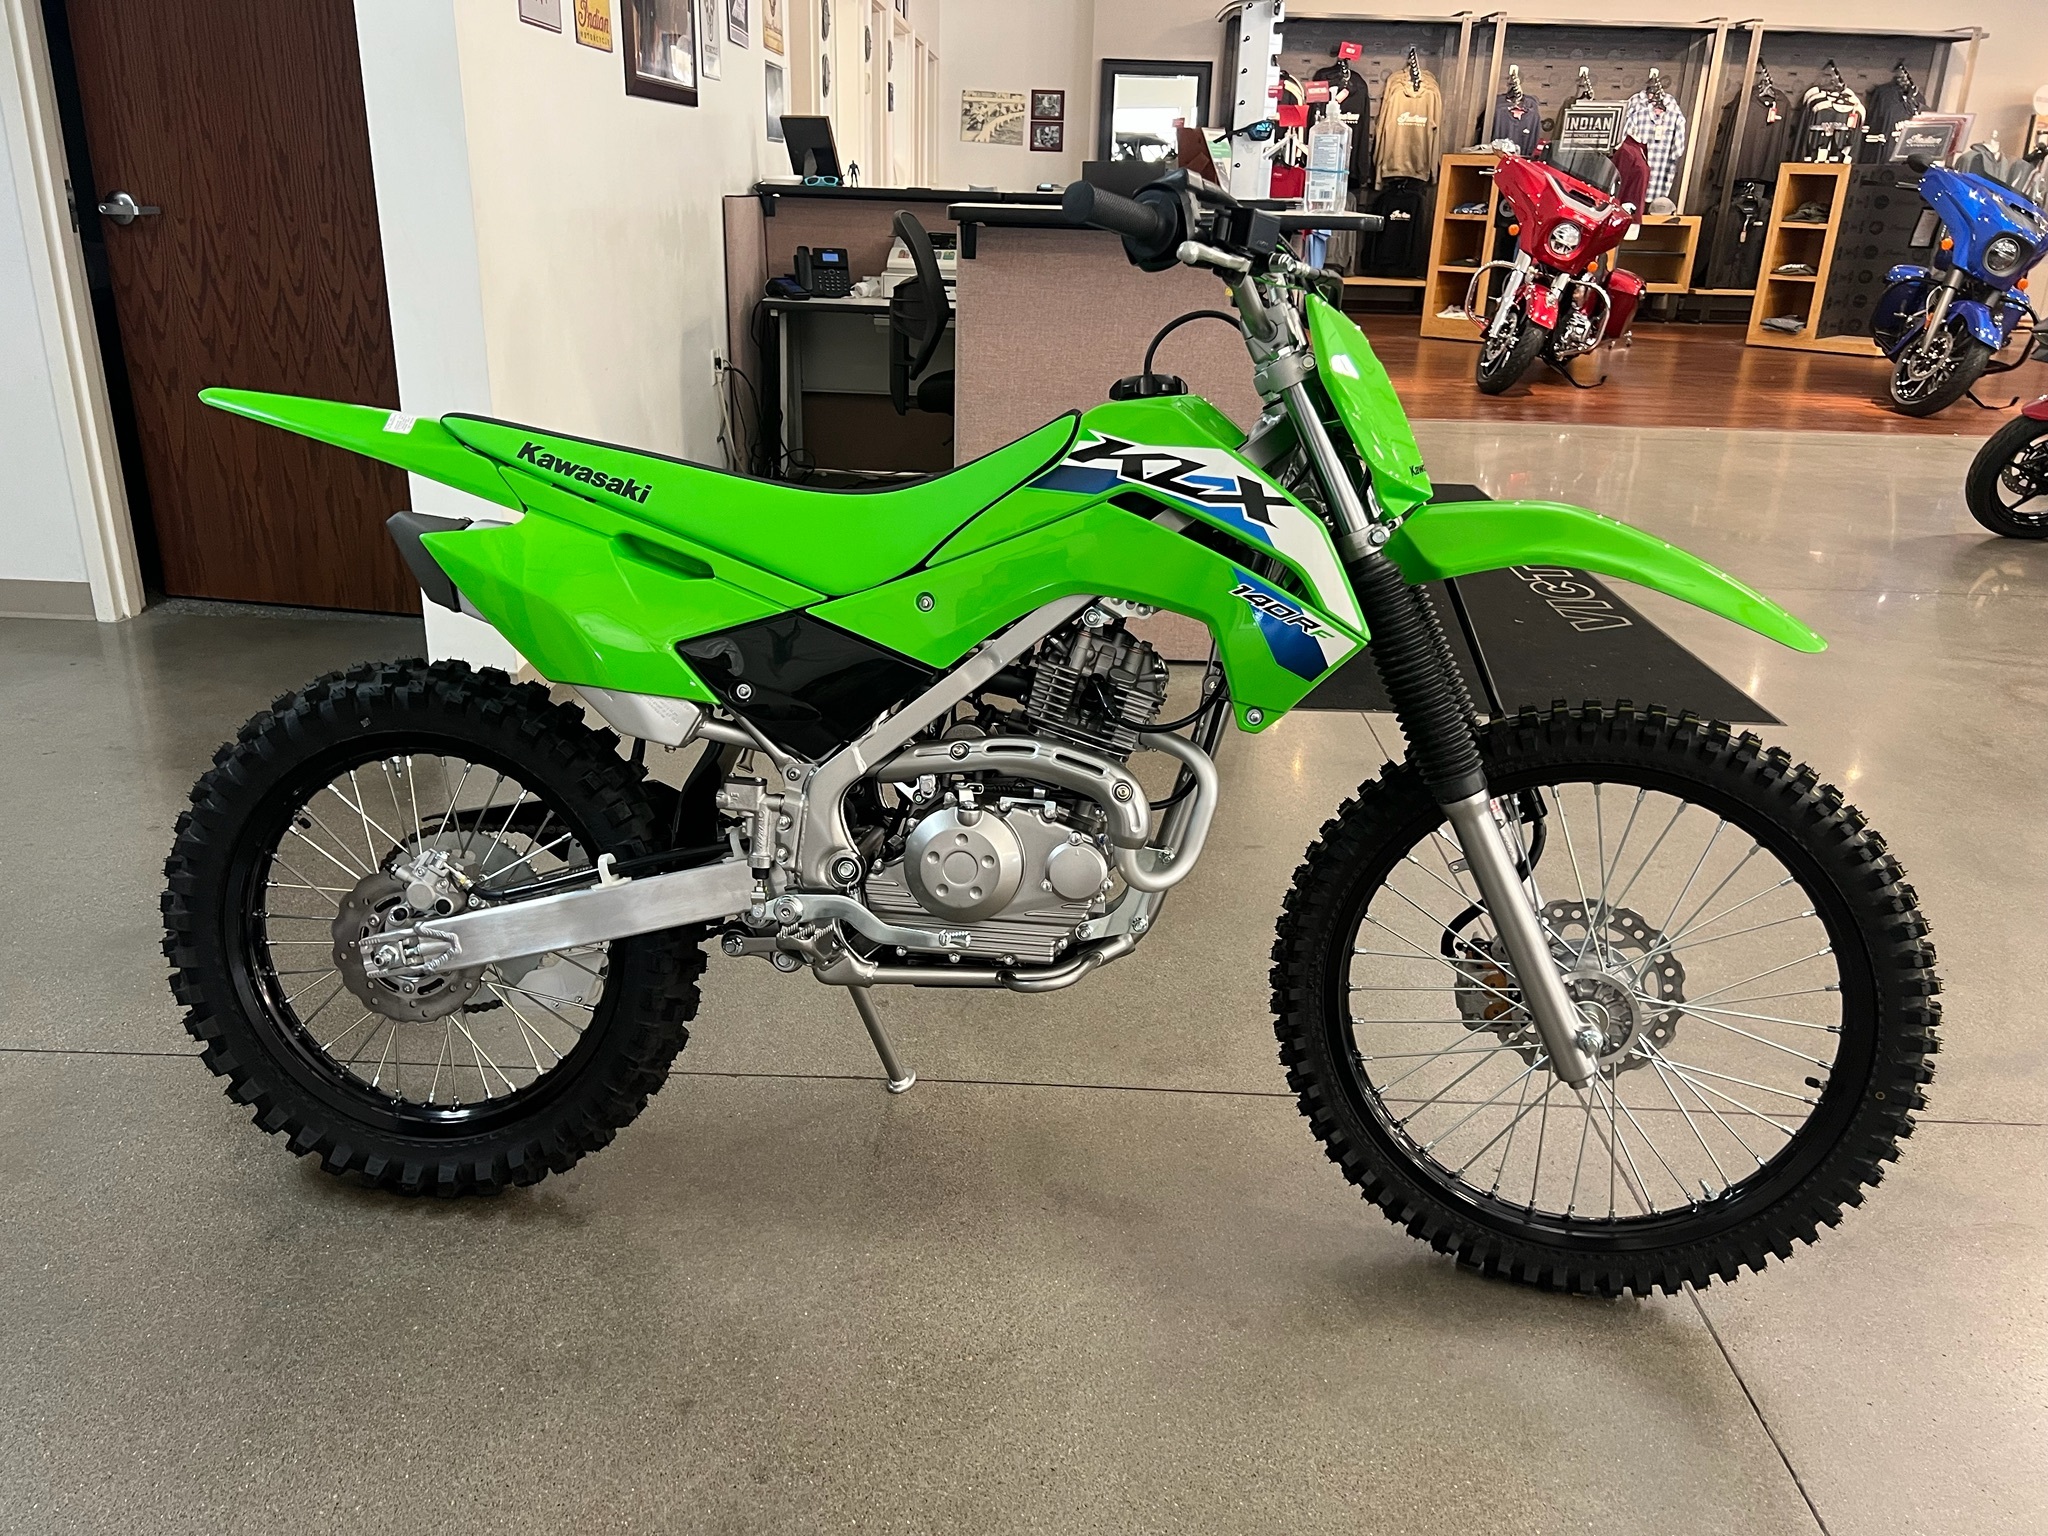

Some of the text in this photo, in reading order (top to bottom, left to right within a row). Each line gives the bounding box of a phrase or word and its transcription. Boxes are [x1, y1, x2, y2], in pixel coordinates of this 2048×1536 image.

[577, 0, 609, 34] Indian
[1566, 117, 1612, 130] INDIAN
[516, 440, 653, 505] Kawasaki
[1067, 433, 1297, 530] KLX
[1508, 564, 1633, 633] VICT
